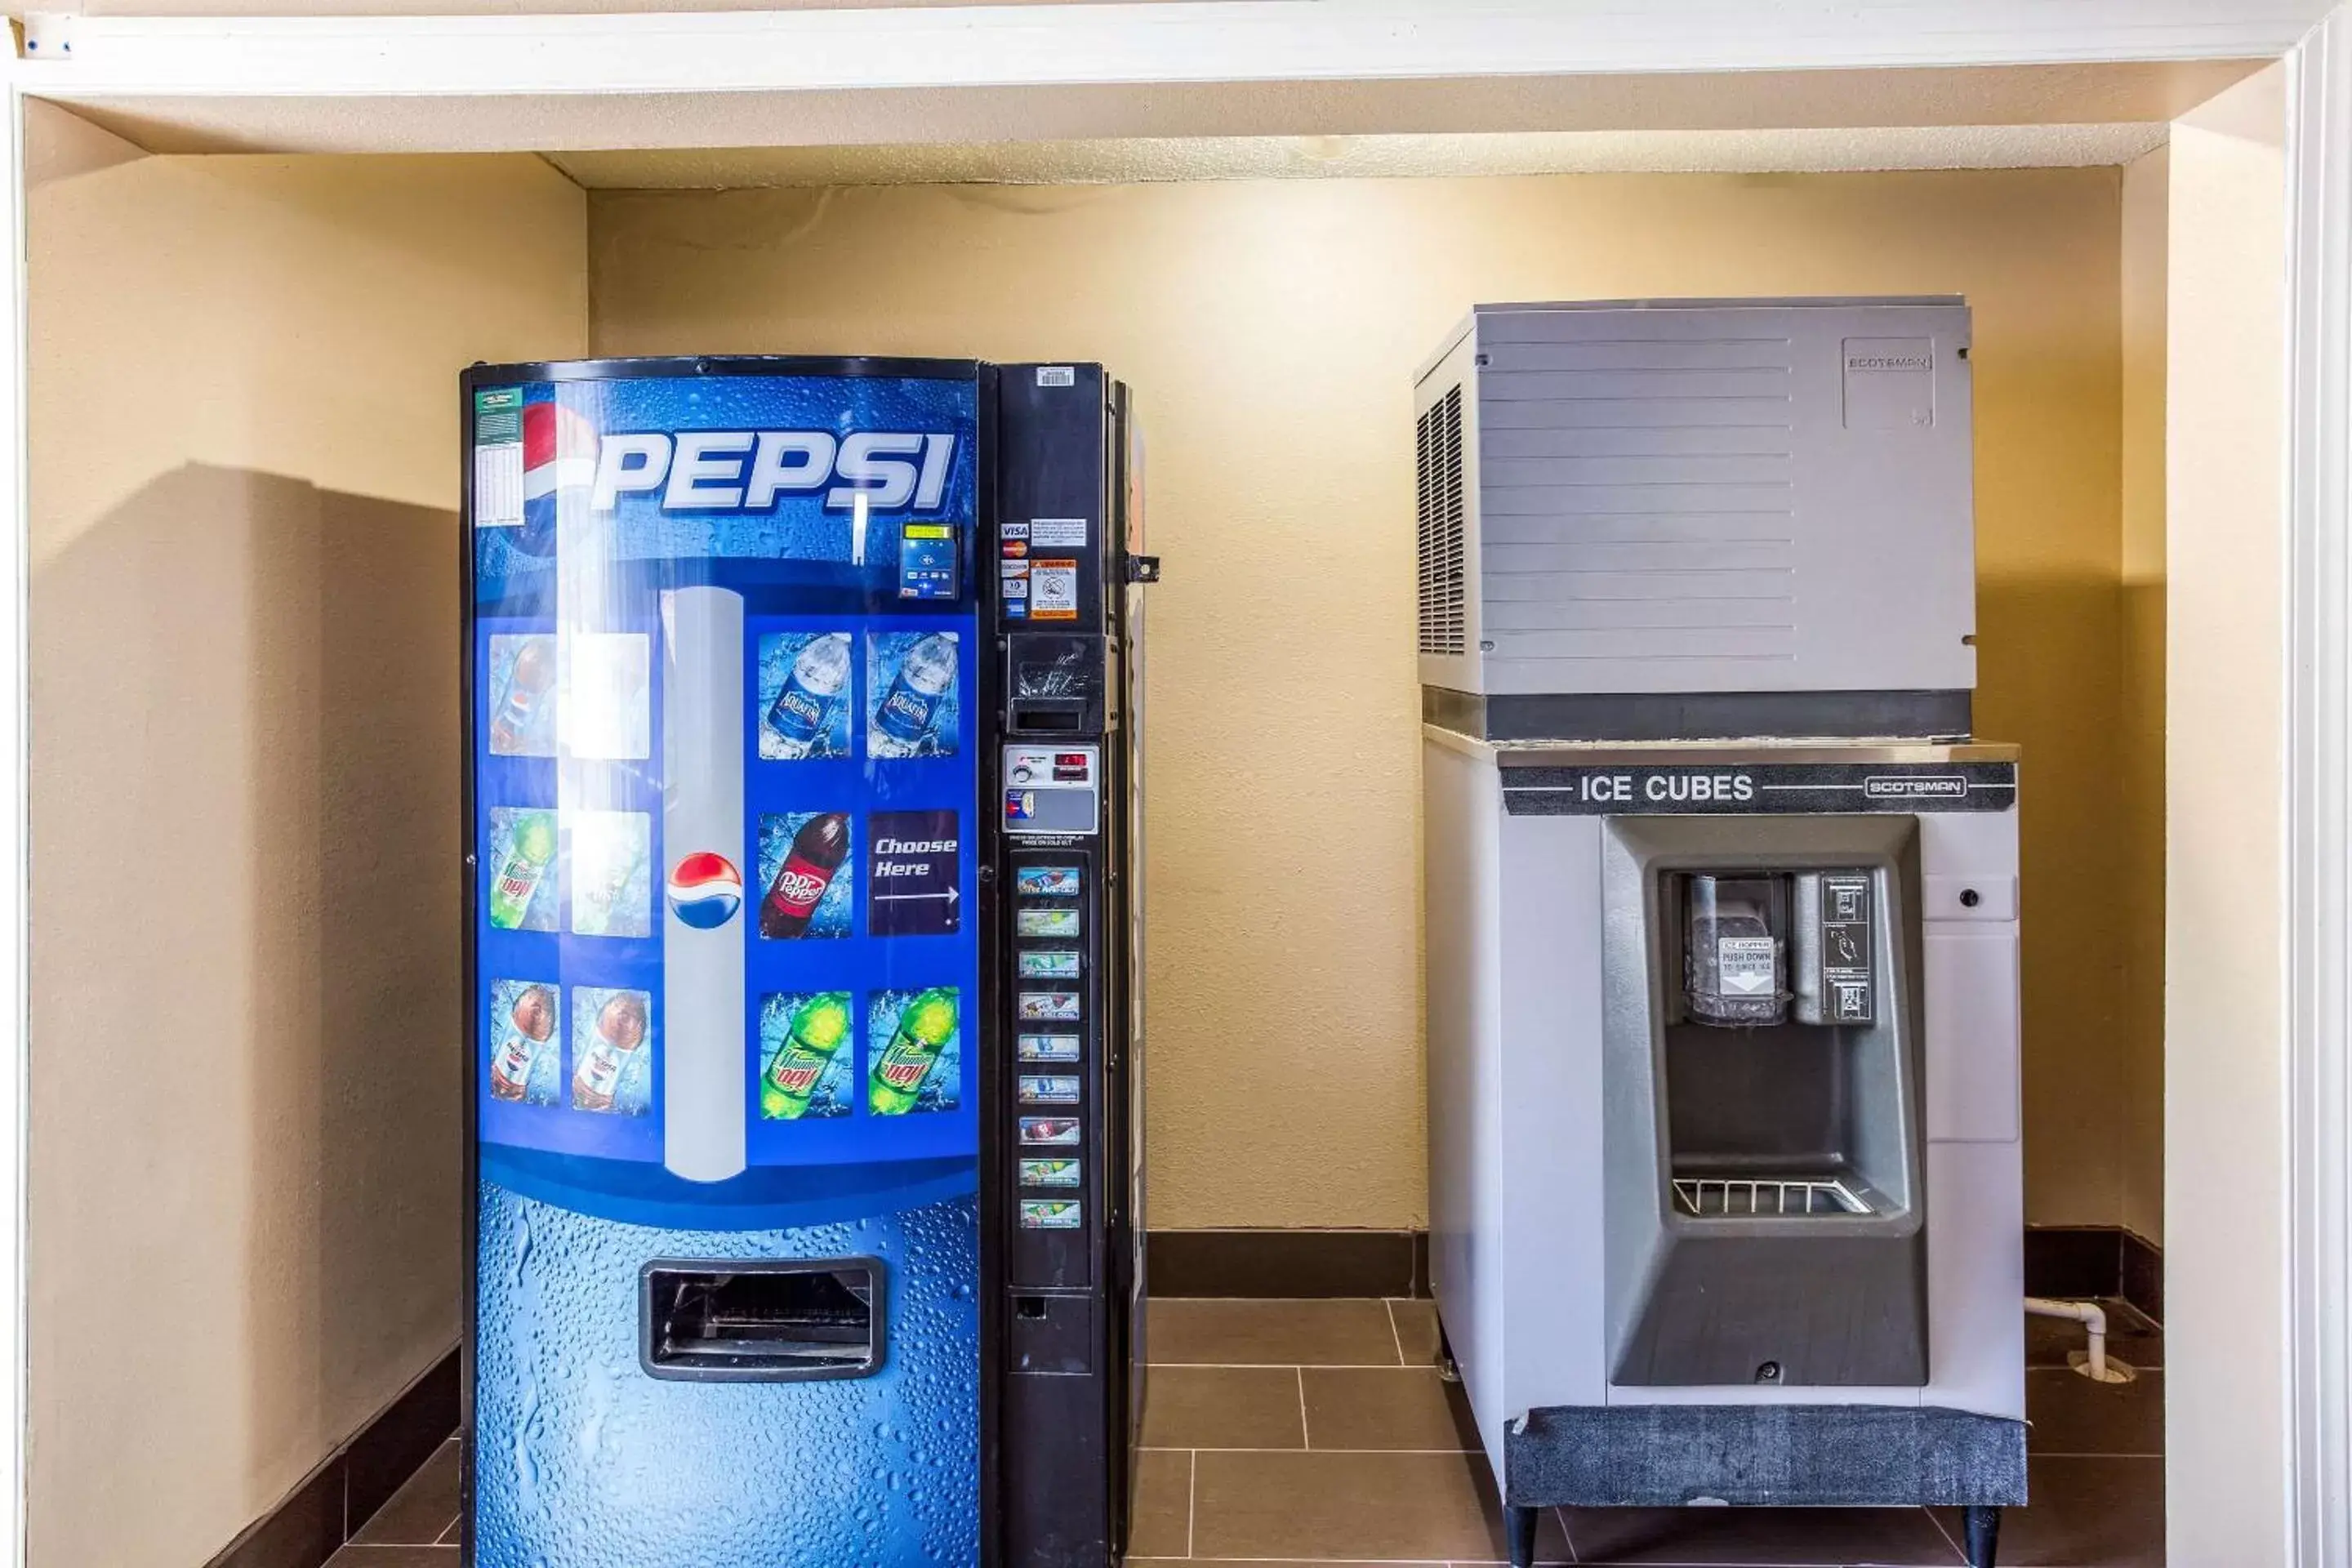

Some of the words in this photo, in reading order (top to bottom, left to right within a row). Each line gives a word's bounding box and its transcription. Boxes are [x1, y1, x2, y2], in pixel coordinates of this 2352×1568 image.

[1848, 359, 1927, 368] SCOTSMAN
[591, 431, 954, 510] PEPSI
[1004, 526, 1027, 536] VISA
[1581, 776, 1632, 800] ICE
[1646, 775, 1753, 800] CUBES
[1869, 782, 1962, 793] SCOTSMAN
[875, 838, 957, 854] Choose
[875, 861, 930, 877] Here
[779, 871, 822, 899] Pepper
[795, 874, 816, 889] Dr
[1722, 952, 1744, 962] PUSH
[1746, 952, 1771, 962] DOWN
